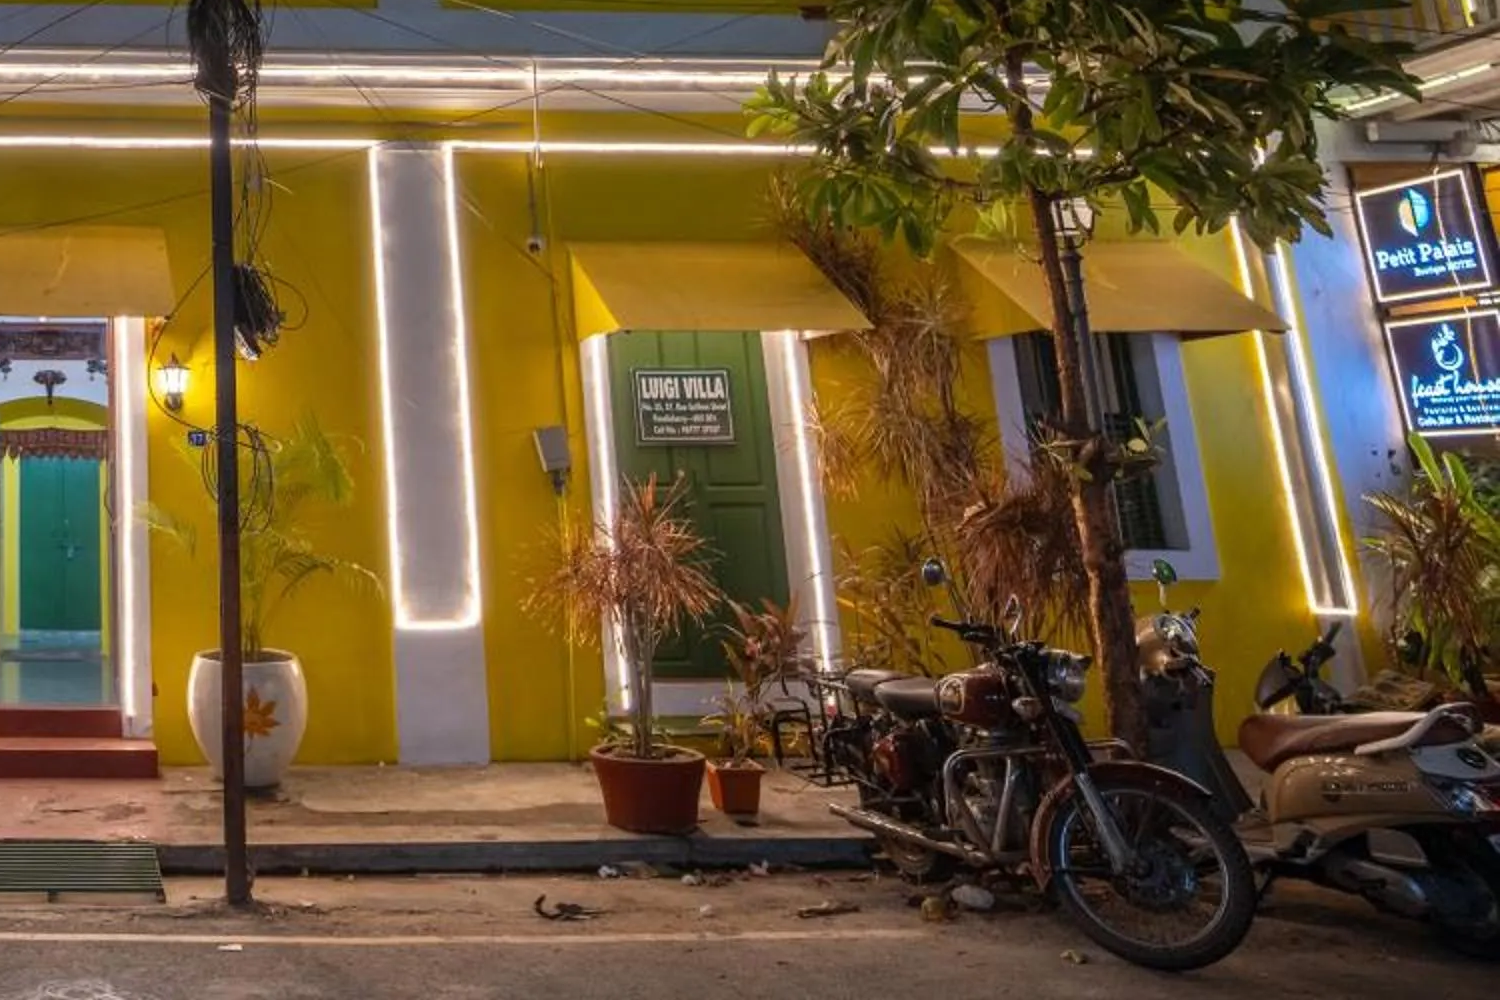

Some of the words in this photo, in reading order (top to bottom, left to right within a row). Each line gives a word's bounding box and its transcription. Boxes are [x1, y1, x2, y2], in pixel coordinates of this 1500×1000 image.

[1375, 248, 1416, 270] Petit
[1418, 237, 1475, 262] Palais
[641, 376, 680, 400] LUIGI
[681, 376, 725, 400] VILLA
[1411, 374, 1453, 408] feast
